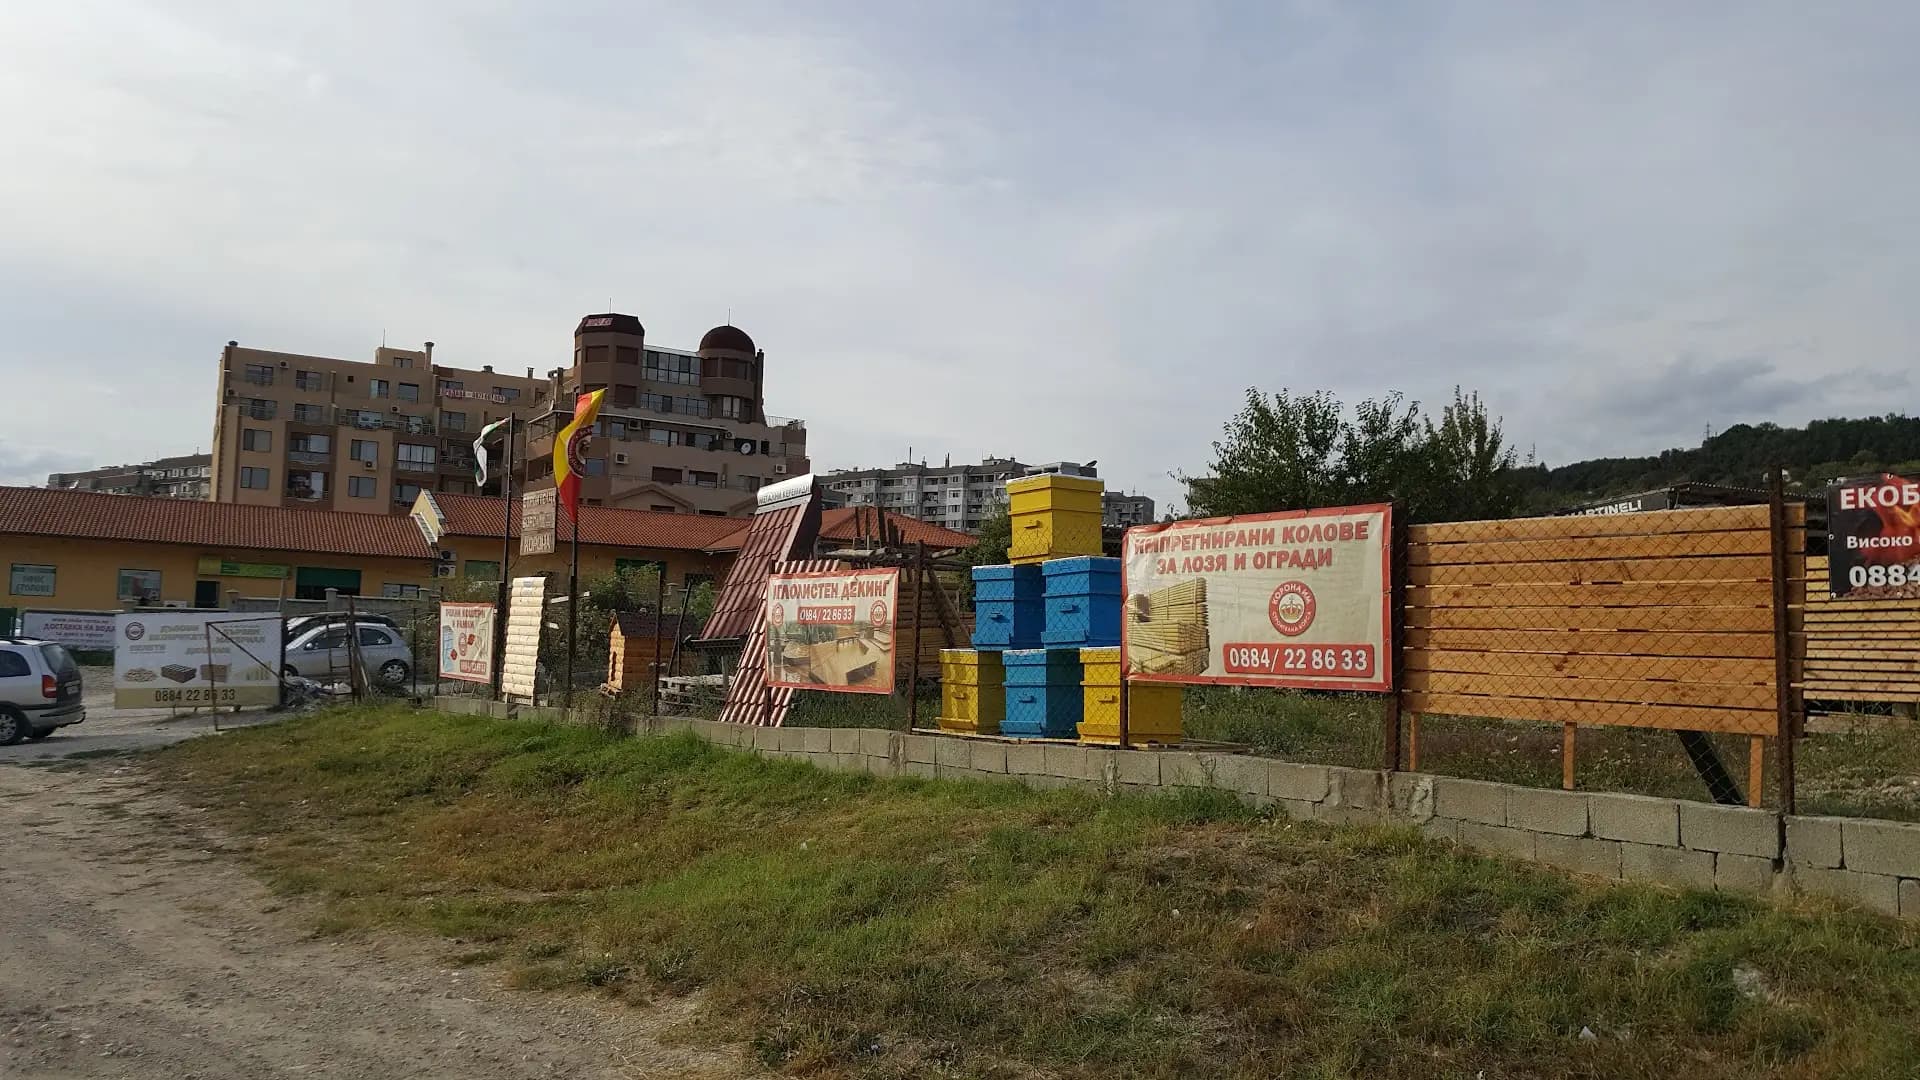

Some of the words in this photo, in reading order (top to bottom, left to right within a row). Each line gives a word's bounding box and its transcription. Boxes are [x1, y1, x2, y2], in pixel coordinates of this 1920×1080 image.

[1565, 500, 1642, 517] RTINELI
[1840, 483, 1920, 510] ЕКОБ
[1134, 527, 1275, 555] ИМПРЕГНИРАНИ
[1282, 520, 1370, 545] КОЛОВЕ
[1846, 535, 1913, 549] Високо
[1155, 557, 1178, 575] ЗА
[1181, 553, 1228, 573] ЛОЗЯ
[1233, 552, 1247, 571] И
[1252, 547, 1333, 571] ОГРАДИ
[1848, 564, 1920, 588] 0884
[841, 579, 890, 601] ДЕКИНГ
[1228, 647, 1280, 673] 0884/
[1284, 647, 1307, 670] 22
[1311, 648, 1336, 671] 86
[1341, 649, 1368, 672] 33
[155, 690, 183, 702] 0884
[185, 689, 201, 701] 22
[221, 688, 236, 700] 33
